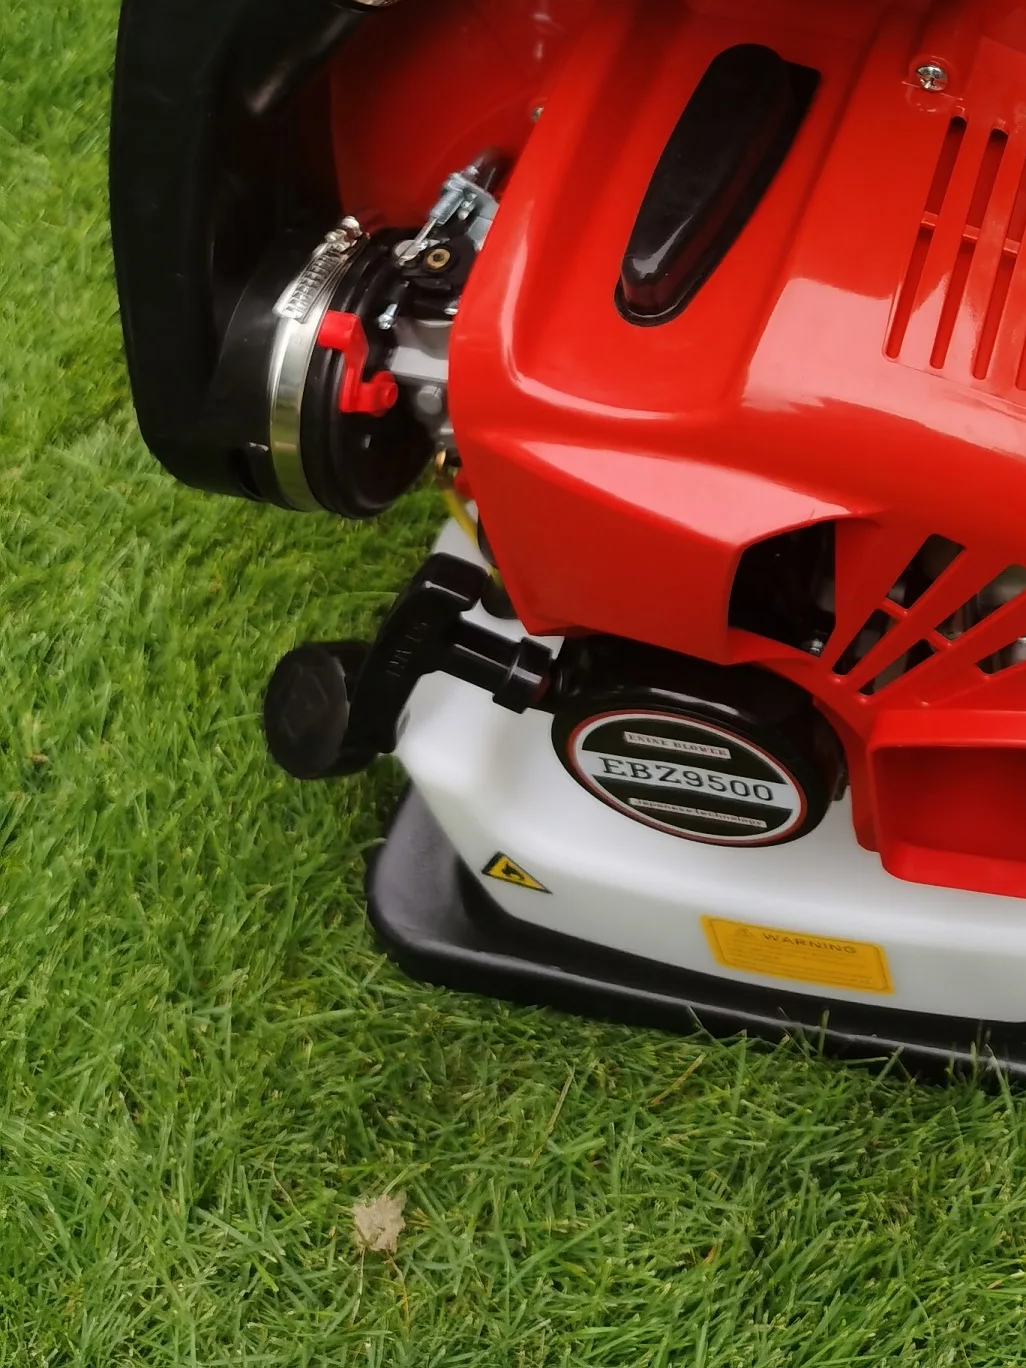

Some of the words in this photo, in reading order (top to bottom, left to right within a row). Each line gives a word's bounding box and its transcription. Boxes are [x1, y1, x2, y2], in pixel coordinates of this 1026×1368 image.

[673, 741, 728, 756] BLOWER
[600, 756, 774, 802] EBZ9500
[762, 932, 857, 954] WARNING
